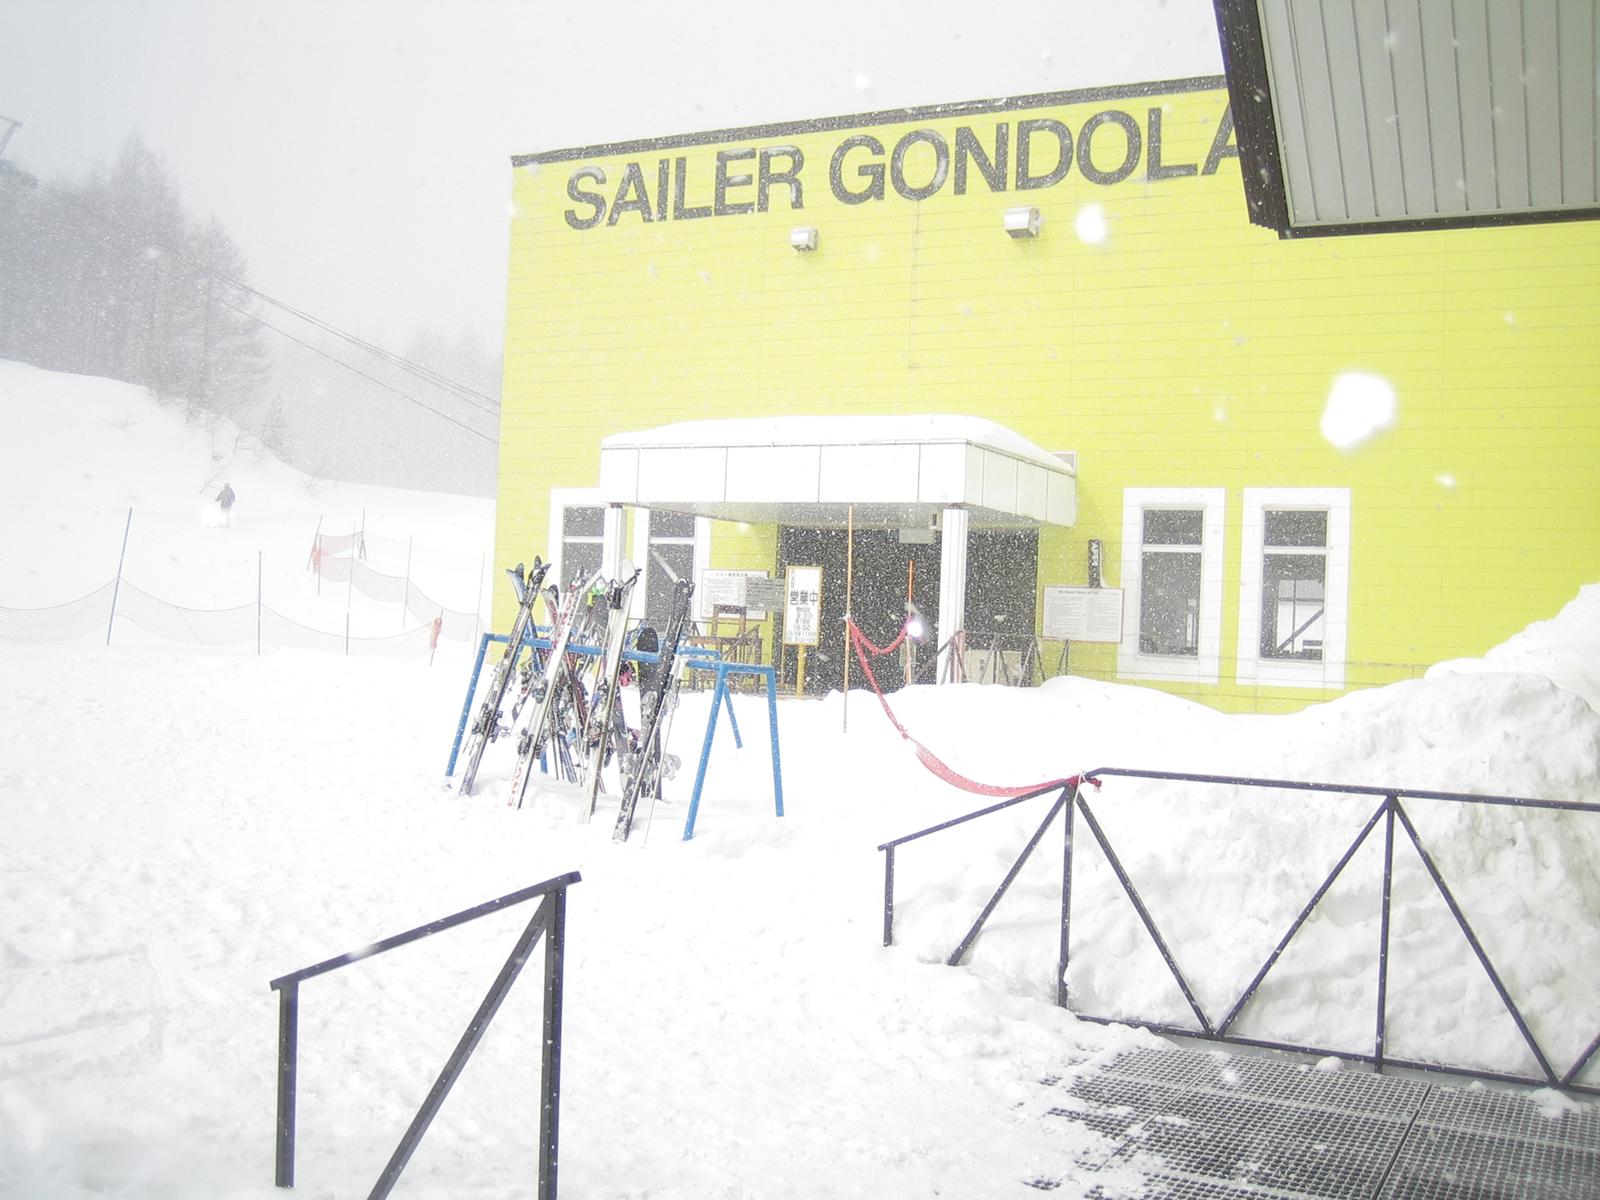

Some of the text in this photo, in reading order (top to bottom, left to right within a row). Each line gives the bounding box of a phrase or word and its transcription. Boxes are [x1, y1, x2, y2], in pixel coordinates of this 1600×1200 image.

[565, 146, 804, 230] SAILER
[790, 589, 819, 606] 営業中
